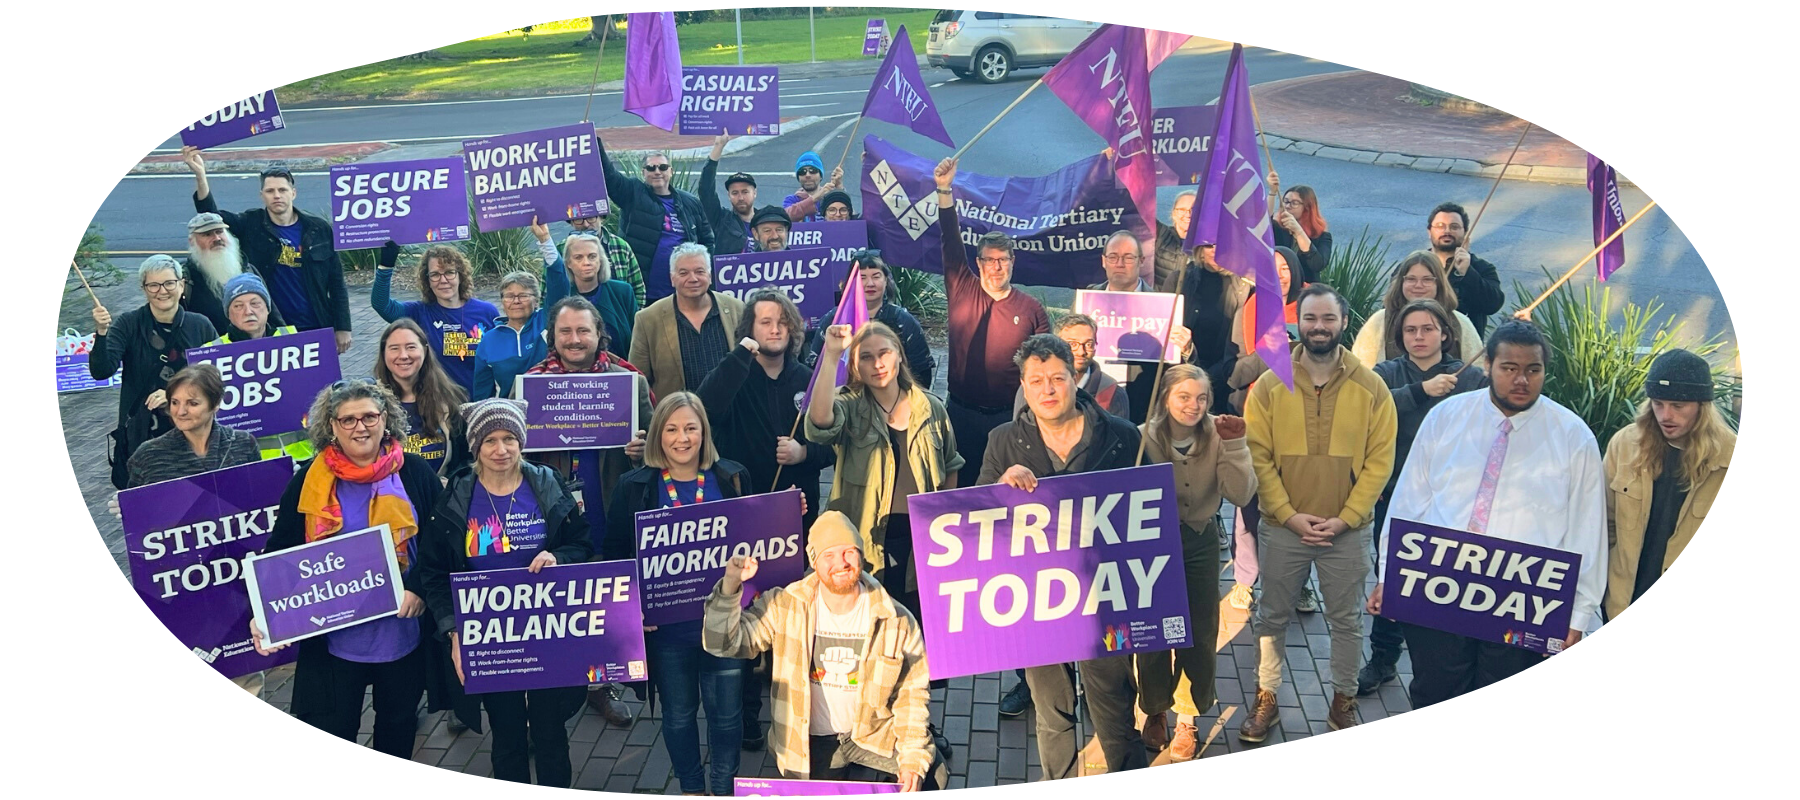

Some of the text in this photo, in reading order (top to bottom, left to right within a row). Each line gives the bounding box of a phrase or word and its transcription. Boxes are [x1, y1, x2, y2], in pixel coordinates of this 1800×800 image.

[189, 91, 266, 131] DAY
[680, 95, 754, 112] RIGHTS
[884, 65, 928, 122] NTEU
[1089, 47, 1147, 158] NTEU
[469, 134, 592, 171] WORK-LIFE
[334, 168, 450, 197] SECURE
[475, 161, 577, 196] BALANCE
[334, 195, 411, 222] JOBS
[955, 198, 1124, 230] National Tertiary
[1090, 308, 1168, 336] fair pay
[198, 343, 320, 381] ECURE
[219, 378, 282, 411] OBS
[546, 391, 593, 400] conditions
[548, 381, 609, 390] Staff working
[541, 401, 615, 411] student learning
[554, 412, 602, 421] conditions.
[640, 516, 729, 550] FAIRER
[927, 488, 1163, 567] STRIKE
[152, 549, 264, 599] TOD
[299, 552, 346, 579] Safe
[642, 534, 799, 580] WORKLOADS
[1396, 532, 1571, 591] STRIKE
[269, 569, 386, 614] workloads
[458, 575, 631, 614] WORK-LIFE
[939, 555, 1171, 633] TODAY
[1399, 568, 1565, 626] TODAY
[462, 609, 606, 646] BALANCE
